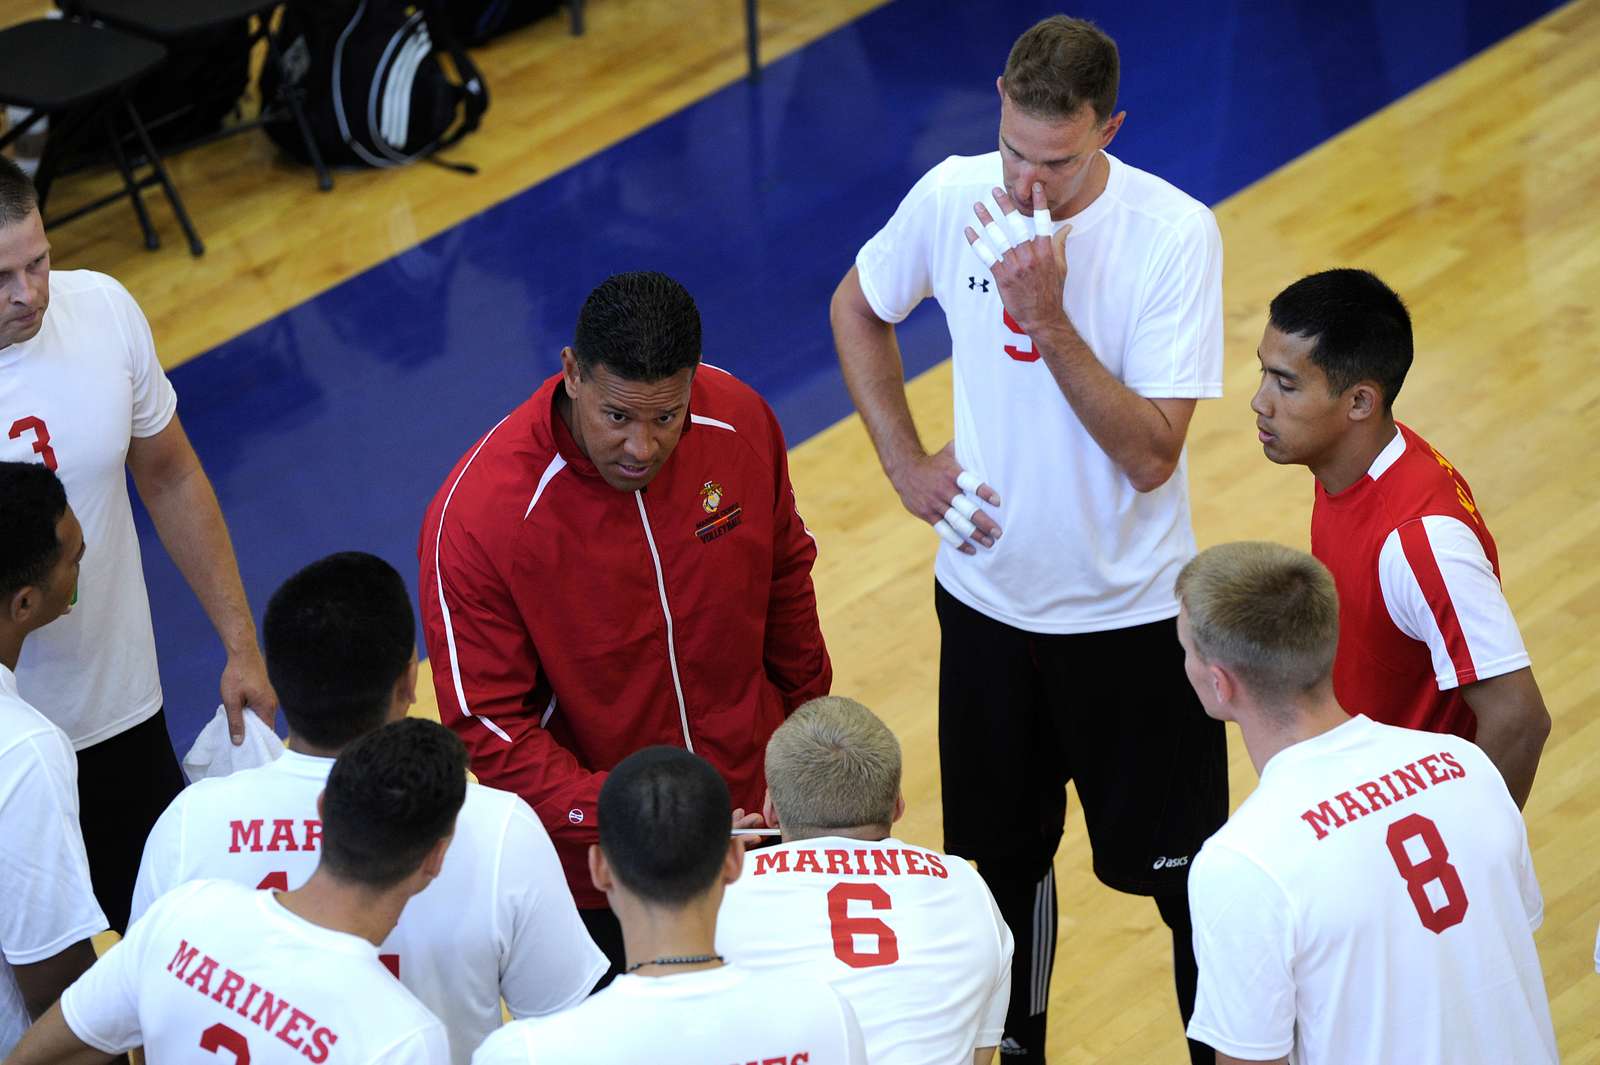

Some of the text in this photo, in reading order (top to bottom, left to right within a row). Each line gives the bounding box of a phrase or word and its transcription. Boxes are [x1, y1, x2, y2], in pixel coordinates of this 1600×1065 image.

[8, 415, 58, 472] 3
[1301, 751, 1466, 840] MARINES
[753, 848, 949, 879] MARINES
[1164, 855, 1189, 868] asics
[1386, 813, 1469, 935] 8
[827, 882, 899, 968] 6
[166, 939, 338, 1064] MARINES
